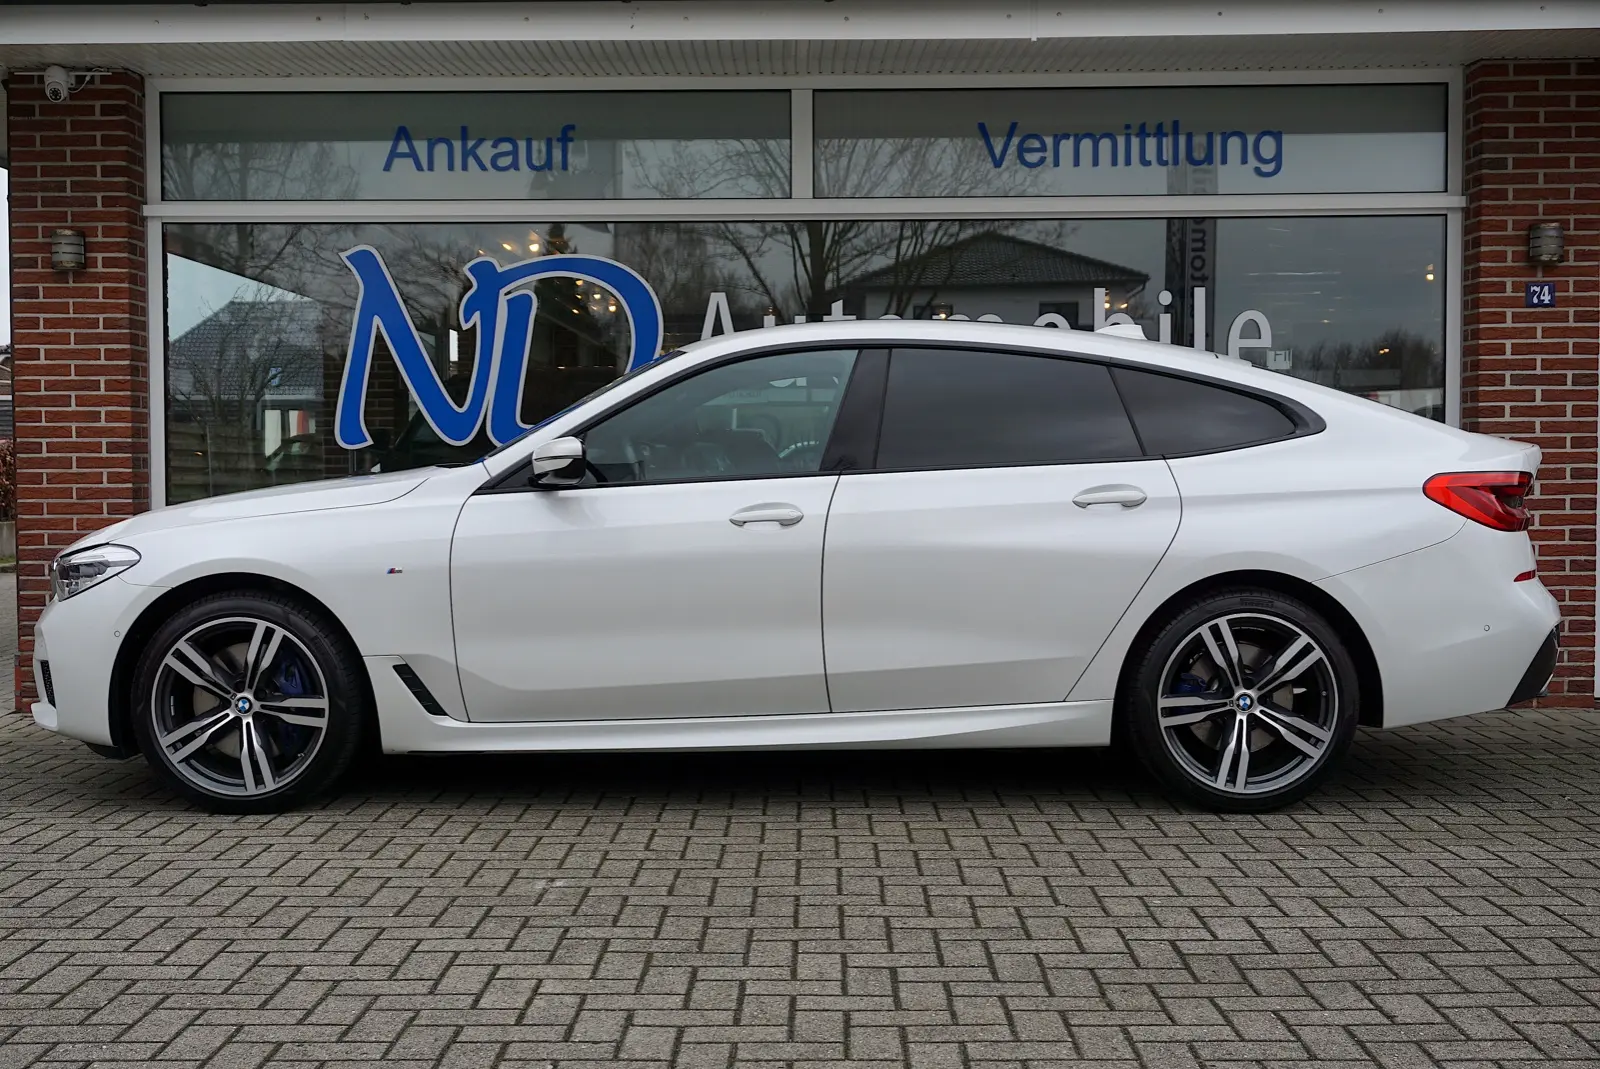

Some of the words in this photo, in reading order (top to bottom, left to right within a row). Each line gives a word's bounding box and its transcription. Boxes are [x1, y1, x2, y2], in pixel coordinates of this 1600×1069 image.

[383, 124, 576, 172] Ankauf
[977, 120, 1283, 178] Vermittlung
[1530, 285, 1551, 304] 74
